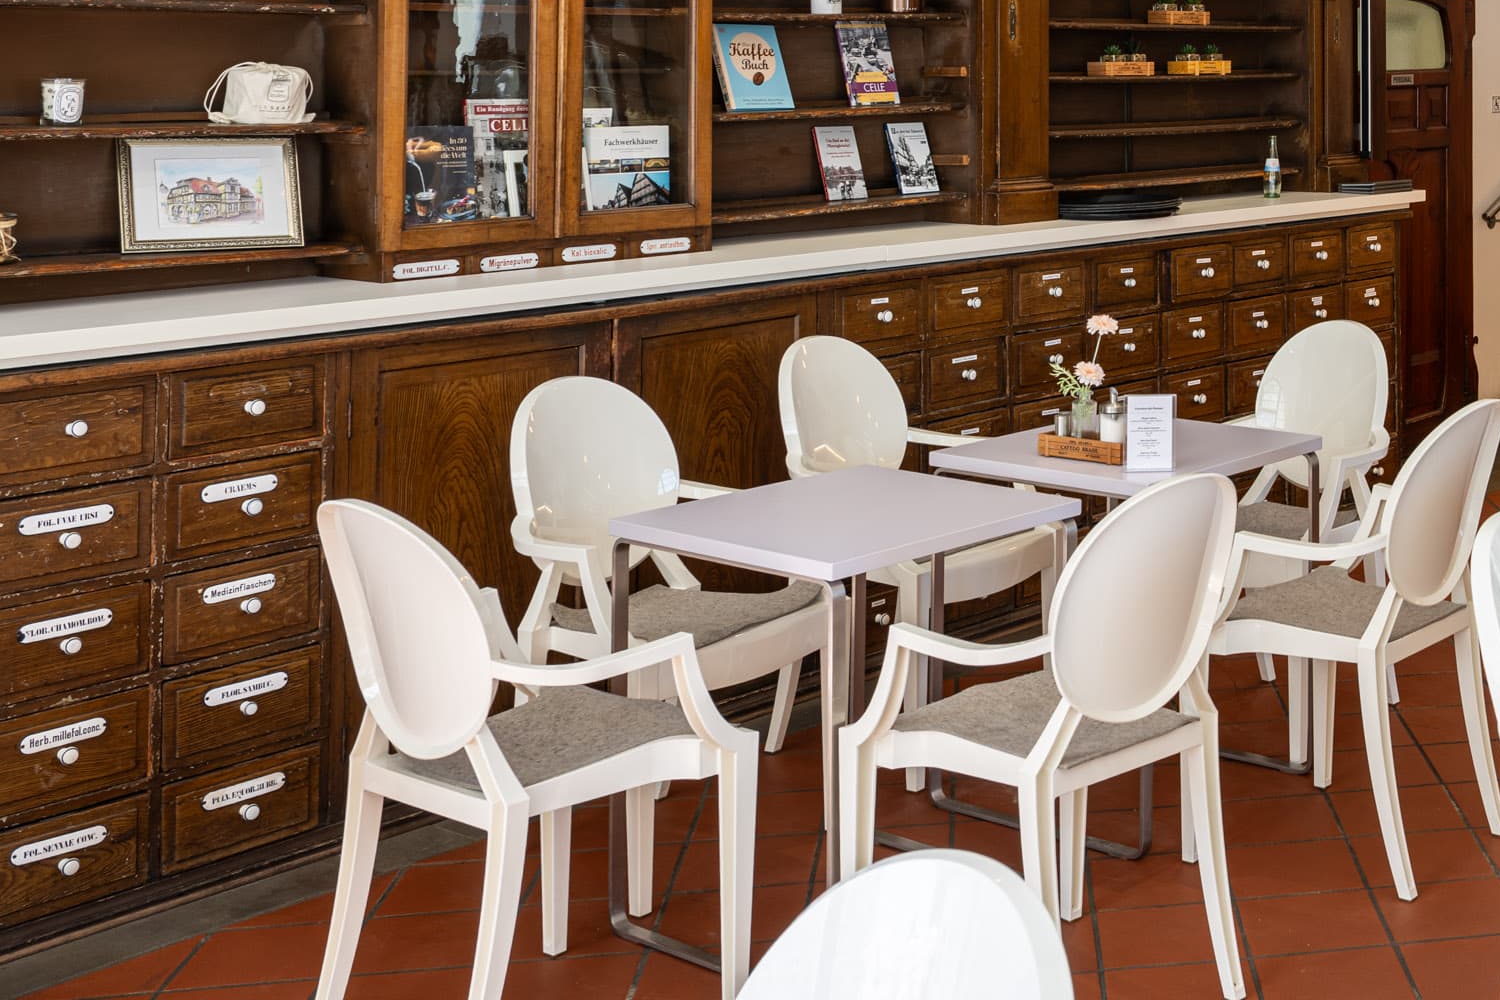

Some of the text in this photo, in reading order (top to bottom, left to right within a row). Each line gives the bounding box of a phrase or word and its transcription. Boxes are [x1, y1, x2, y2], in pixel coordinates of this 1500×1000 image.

[729, 42, 775, 60] Kaffee
[741, 58, 769, 70] Buch
[863, 82, 886, 92] CELLE
[604, 137, 658, 146] Fachwerkhäuser
[488, 256, 533, 269] Migränepulver
[210, 579, 272, 598] Medizinflaschen
